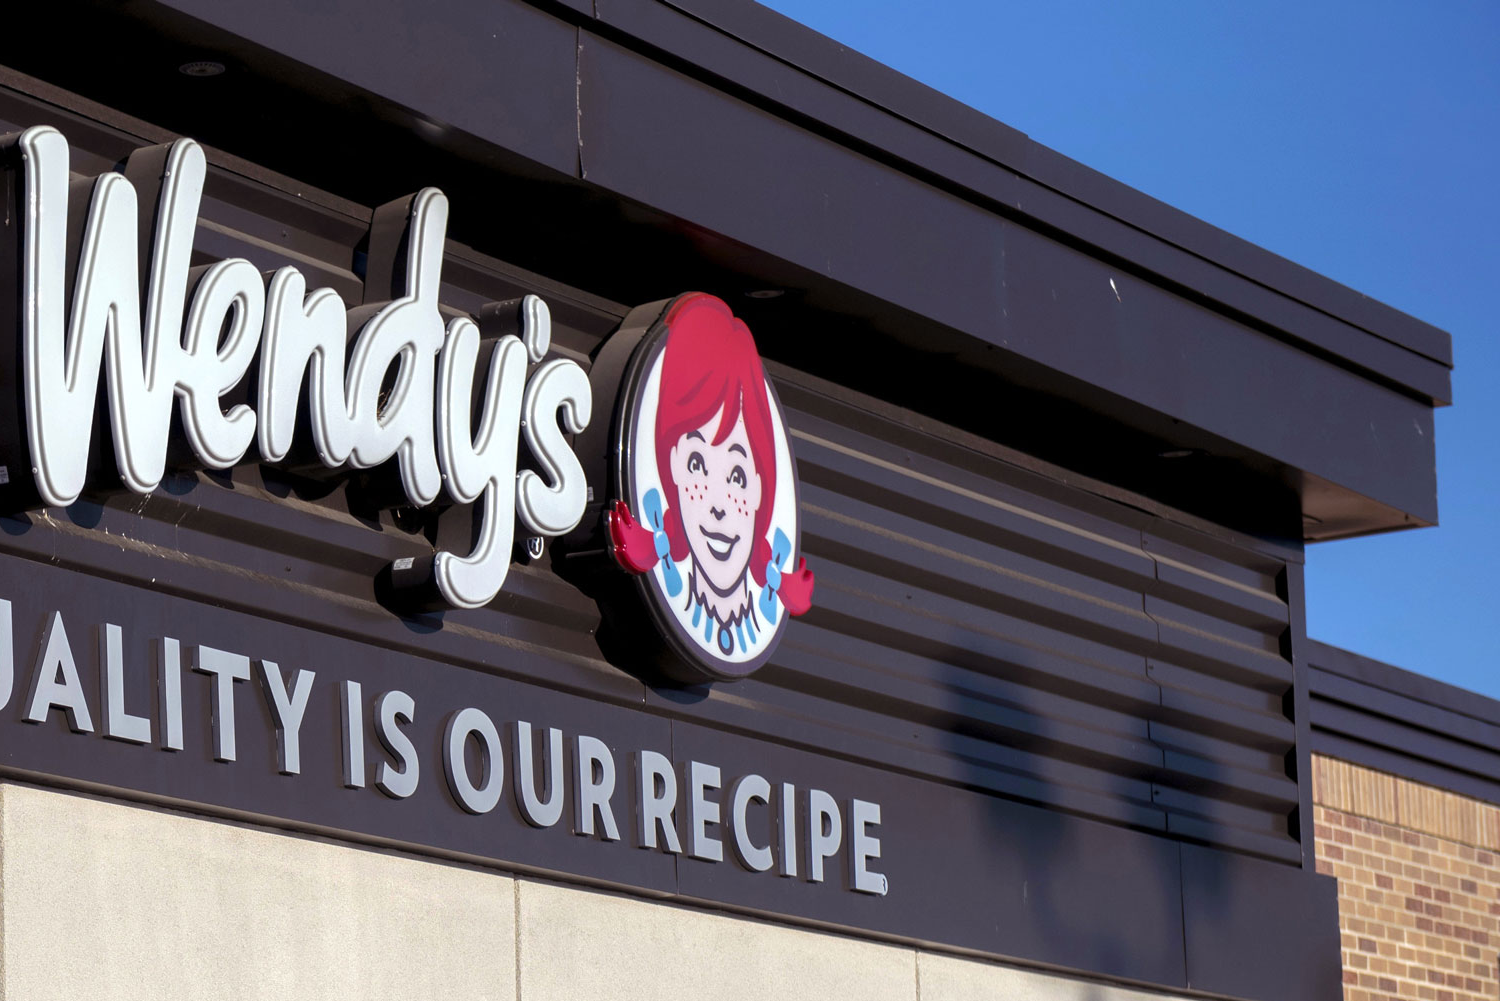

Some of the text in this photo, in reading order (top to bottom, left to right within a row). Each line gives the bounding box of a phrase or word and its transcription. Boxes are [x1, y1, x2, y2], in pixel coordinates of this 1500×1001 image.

[19, 125, 592, 609] Wendy's
[340, 680, 419, 799] IS
[443, 707, 621, 841] OUR
[635, 750, 886, 896] RECIPE
